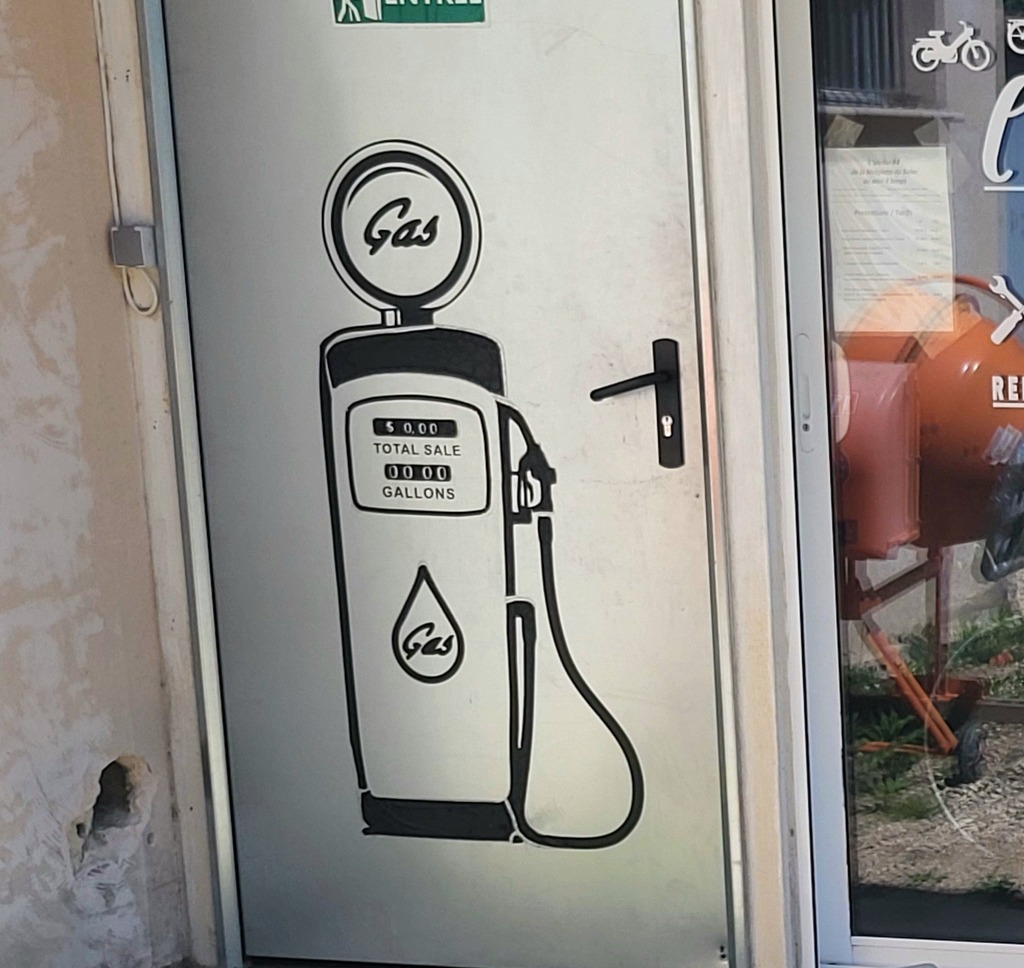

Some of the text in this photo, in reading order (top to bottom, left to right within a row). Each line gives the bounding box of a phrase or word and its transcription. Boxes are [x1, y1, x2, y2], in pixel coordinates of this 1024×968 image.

[364, 197, 439, 255] Gas
[373, 443, 462, 457] TOTAL SALE
[382, 486, 456, 500] GALLONS
[402, 622, 455, 660] Gas
